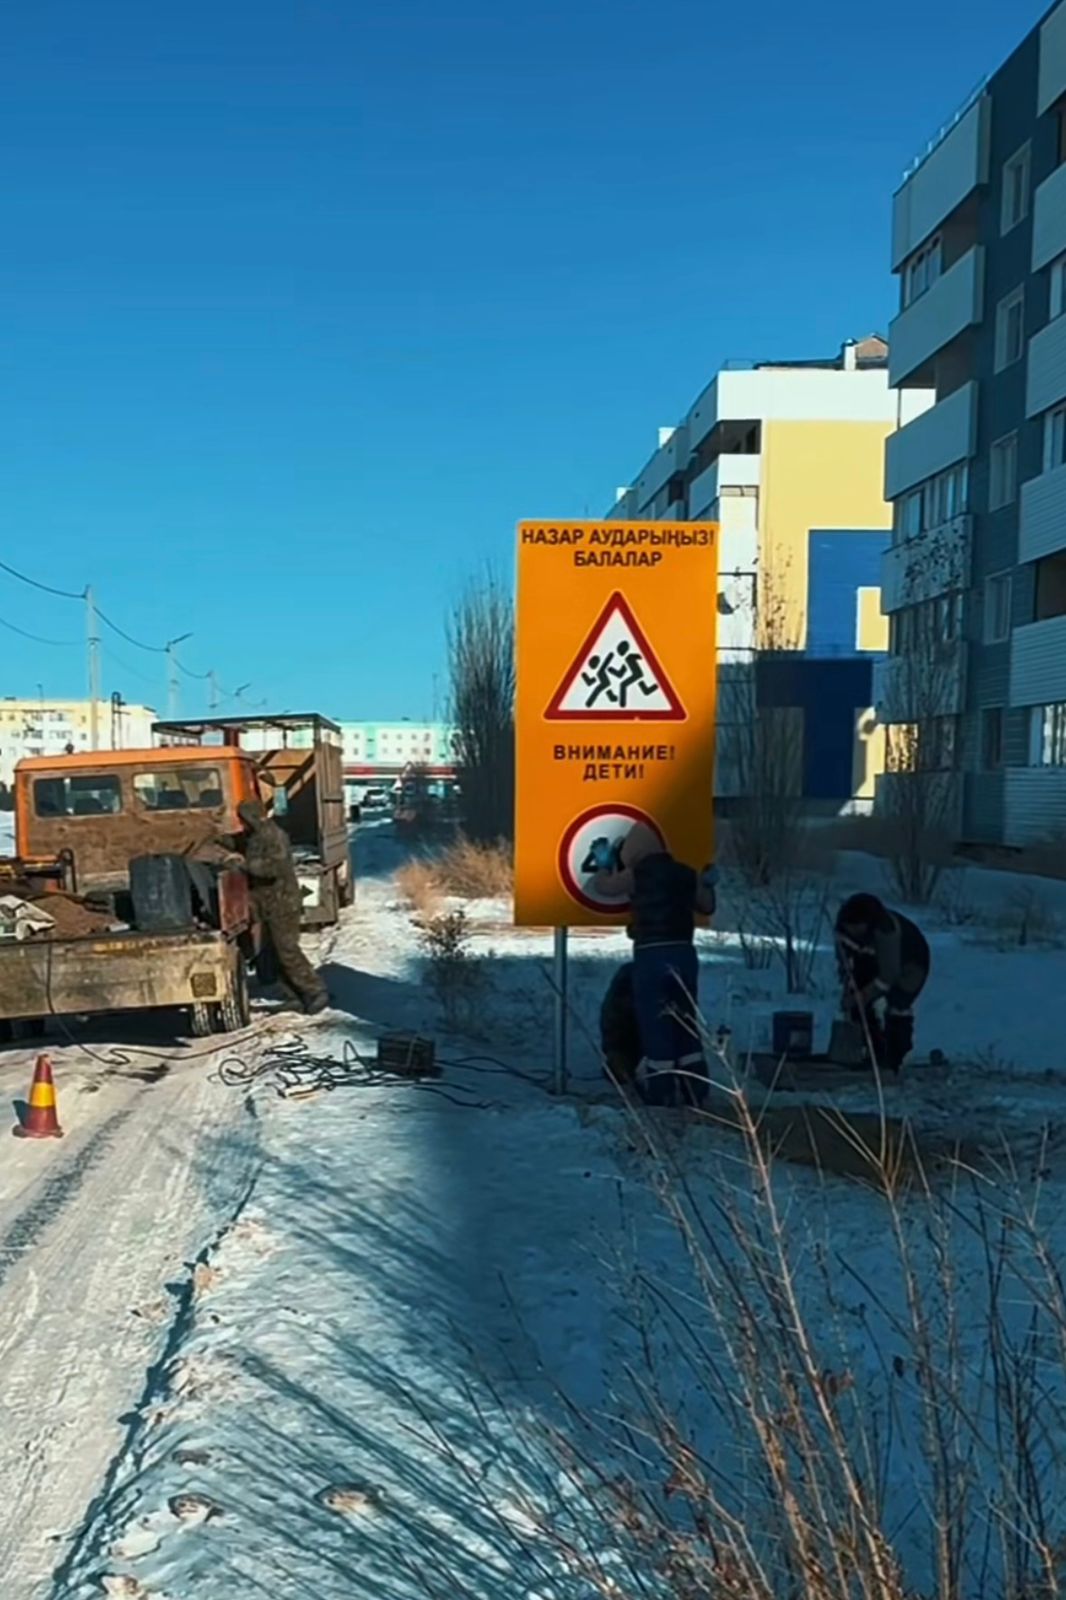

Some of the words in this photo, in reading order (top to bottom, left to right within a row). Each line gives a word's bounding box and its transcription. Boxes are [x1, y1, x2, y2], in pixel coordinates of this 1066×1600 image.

[522, 528, 584, 545] НАЗАР
[589, 528, 714, 548] АУДАРЫҢЫЗ!
[573, 551, 662, 567] БАЛАЛАР
[553, 745, 676, 760] ВНИМАНИЕ!
[583, 764, 644, 781] ДЕТИ!
